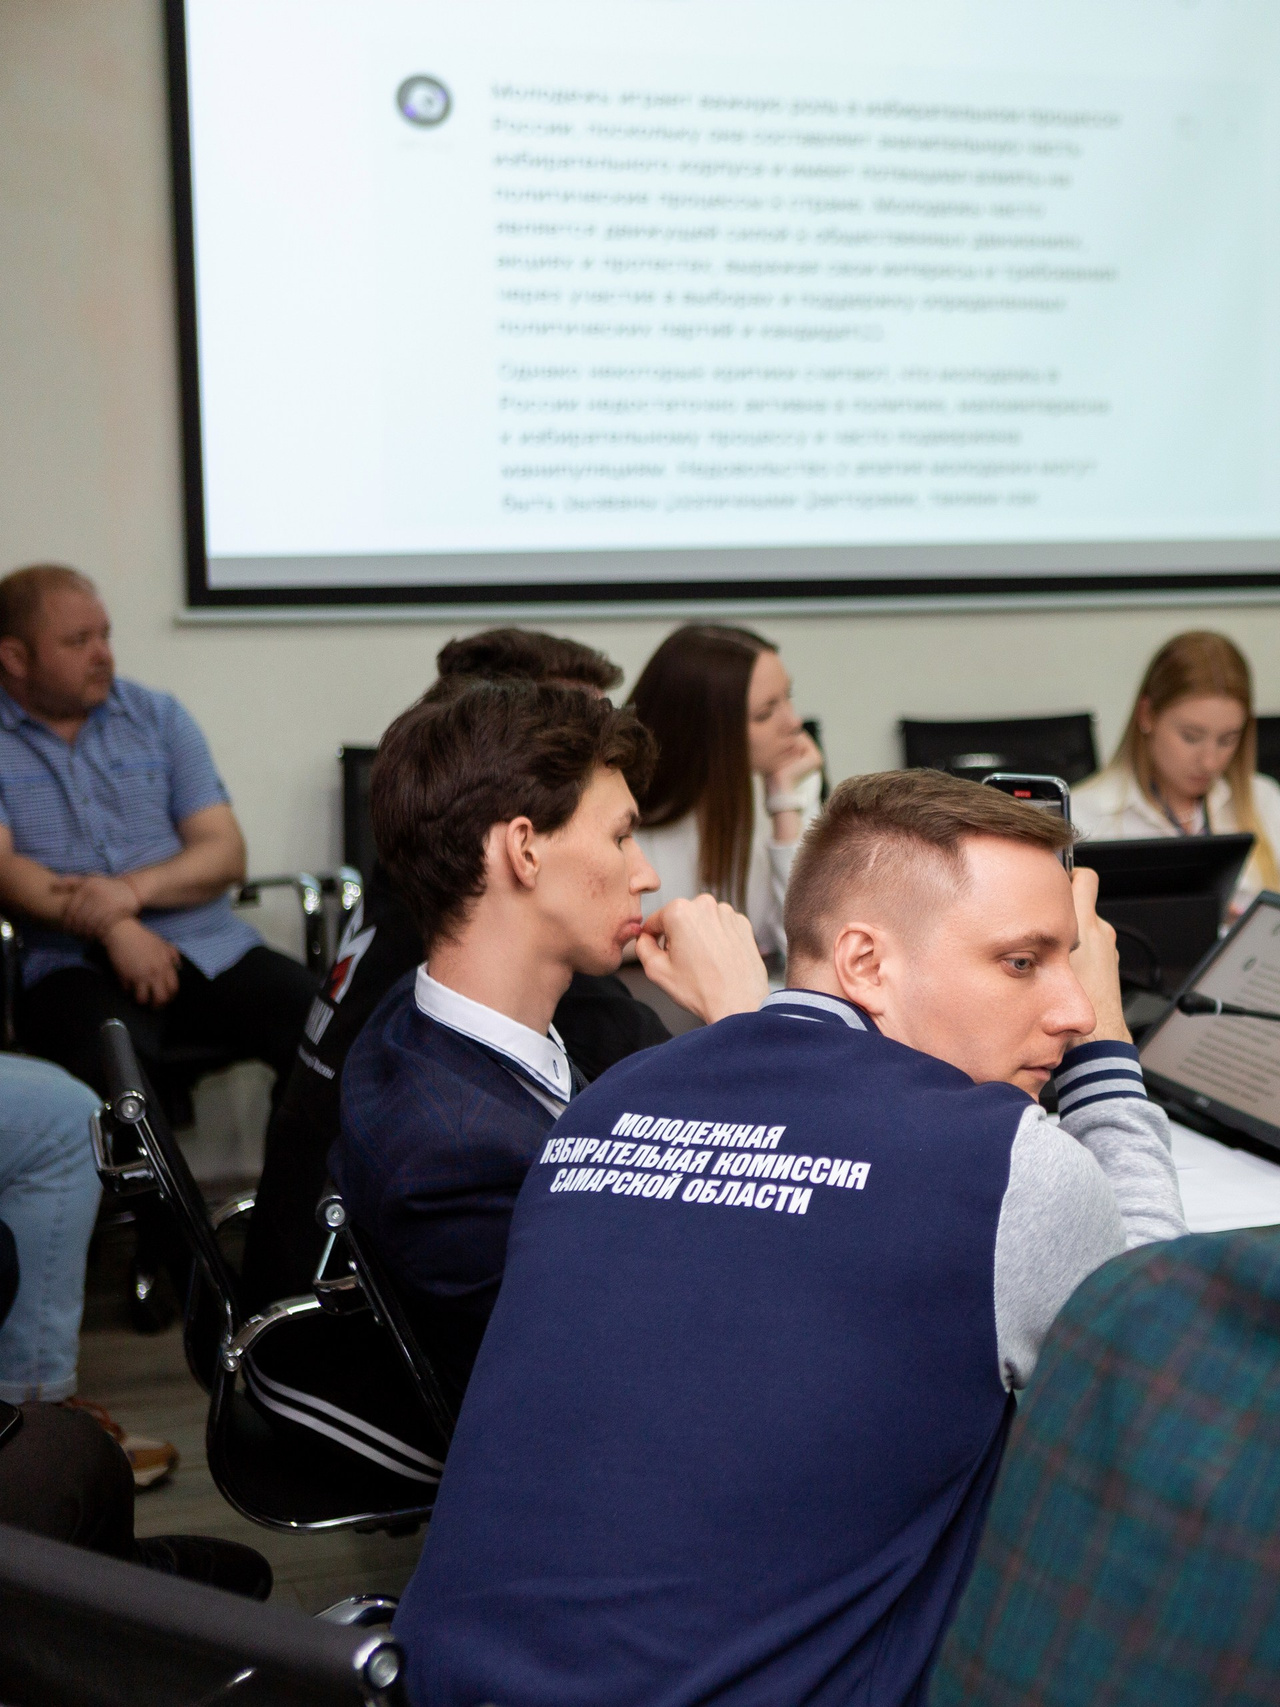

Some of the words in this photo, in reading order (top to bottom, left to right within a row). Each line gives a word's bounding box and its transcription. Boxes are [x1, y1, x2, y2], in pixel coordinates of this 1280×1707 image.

[611, 1112, 787, 1150] МОЛОДЕЖНАЯ
[539, 1138, 714, 1175] ИЗБИРАТЕЛЬНАЯ
[710, 1152, 872, 1190] КОМИССИЯ
[549, 1167, 684, 1201] САМАРСКОЙ
[681, 1178, 814, 1215] ОБЛАСТИ
